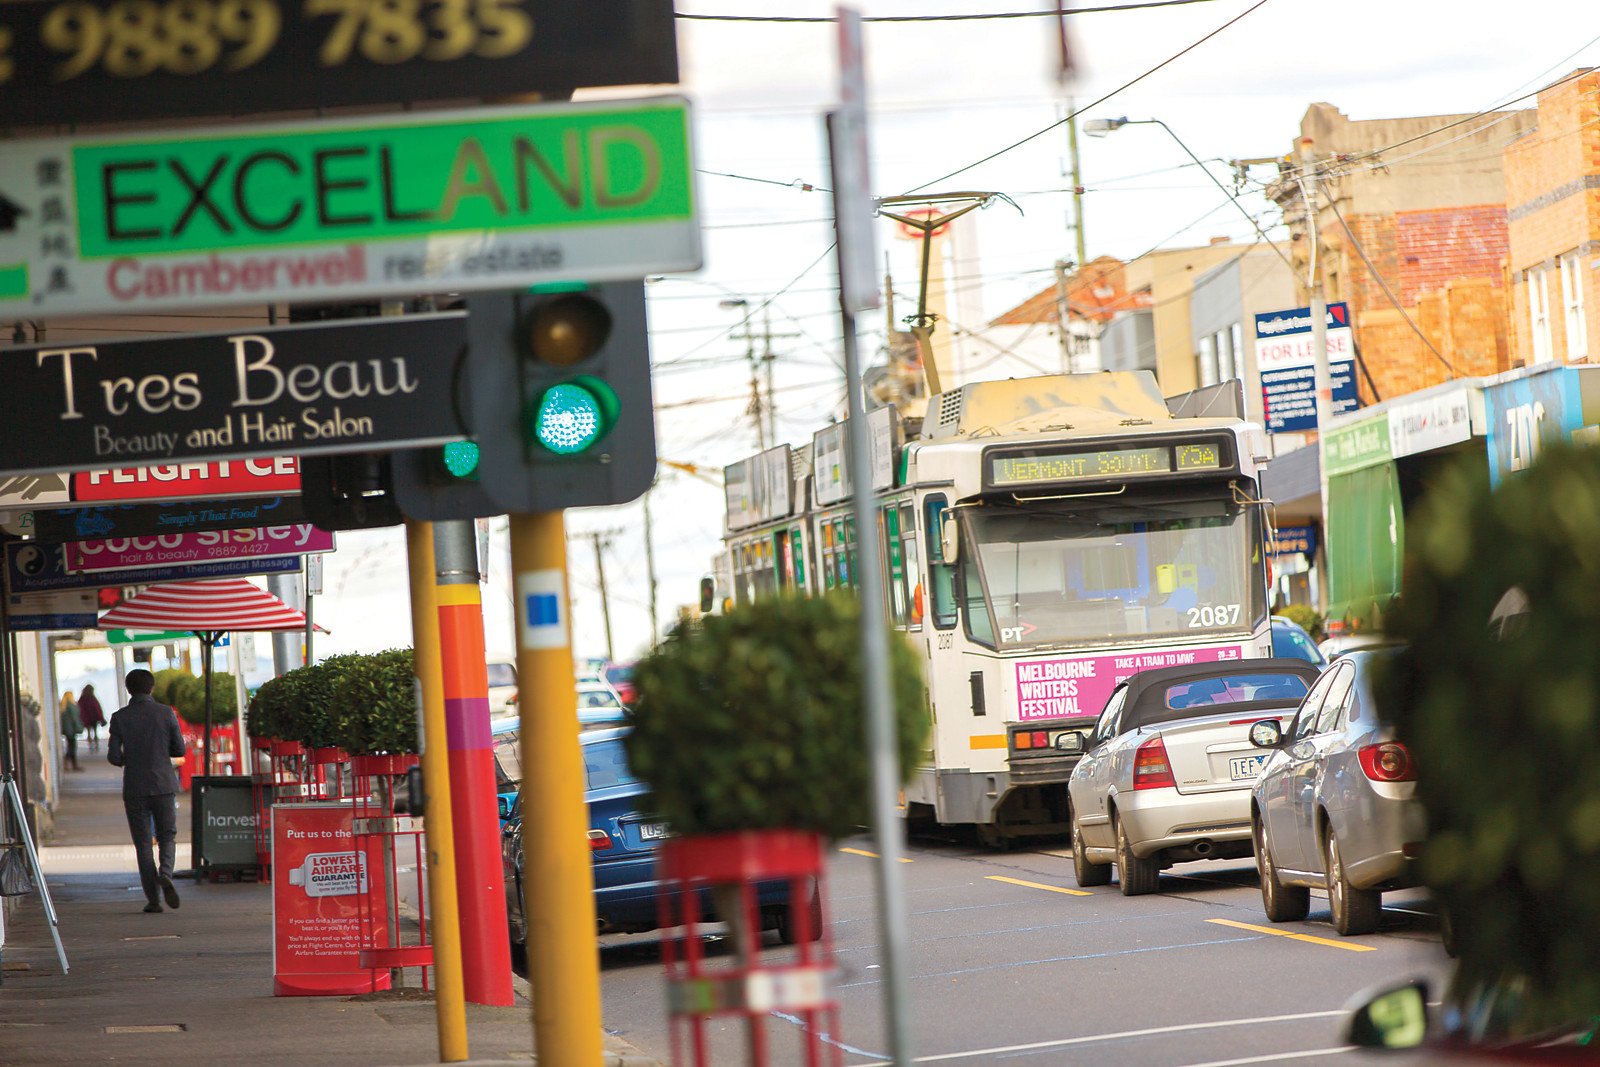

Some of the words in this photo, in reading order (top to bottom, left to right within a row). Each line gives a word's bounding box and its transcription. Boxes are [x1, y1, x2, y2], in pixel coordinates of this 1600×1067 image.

[40, 0, 282, 82] 9889
[102, 125, 662, 241] EXCELAND
[106, 244, 368, 301] Camberwell
[1261, 344, 1293, 360] FOR
[1297, 337, 1348, 357] LESE
[37, 347, 202, 420] Tres
[227, 335, 418, 407] Beau
[94, 426, 178, 456] Beauty
[186, 415, 233, 448] and
[242, 412, 296, 444] Hair
[302, 407, 373, 440] Salon
[245, 455, 301, 476] CE
[229, 507, 259, 519] Food
[120, 552, 143, 563] hair
[146, 552, 155, 561] &
[158, 548, 199, 562] beauty
[207, 546, 237, 557] 9889
[240, 544, 269, 555] 4427
[251, 558, 294, 570] Massage
[1187, 604, 1241, 628] 2087
[938, 633, 953, 650] 2087
[1114, 657, 1134, 669] TAKE
[1135, 657, 1141, 668] A
[1142, 655, 1164, 667] TRAM
[1165, 654, 1176, 665] TO
[1176, 652, 1195, 665] MWF
[1018, 660, 1097, 682] MELBOURNE
[1020, 679, 1079, 700] WRITERS
[1021, 697, 1082, 717] FESTIVAL
[207, 810, 261, 827] harvest
[287, 829, 305, 839] Put
[321, 830, 332, 838] to
[335, 829, 352, 838] the
[311, 863, 364, 876] AIRFARE
[312, 855, 361, 867] LOWEST
[311, 872, 366, 883] GUARANTE
